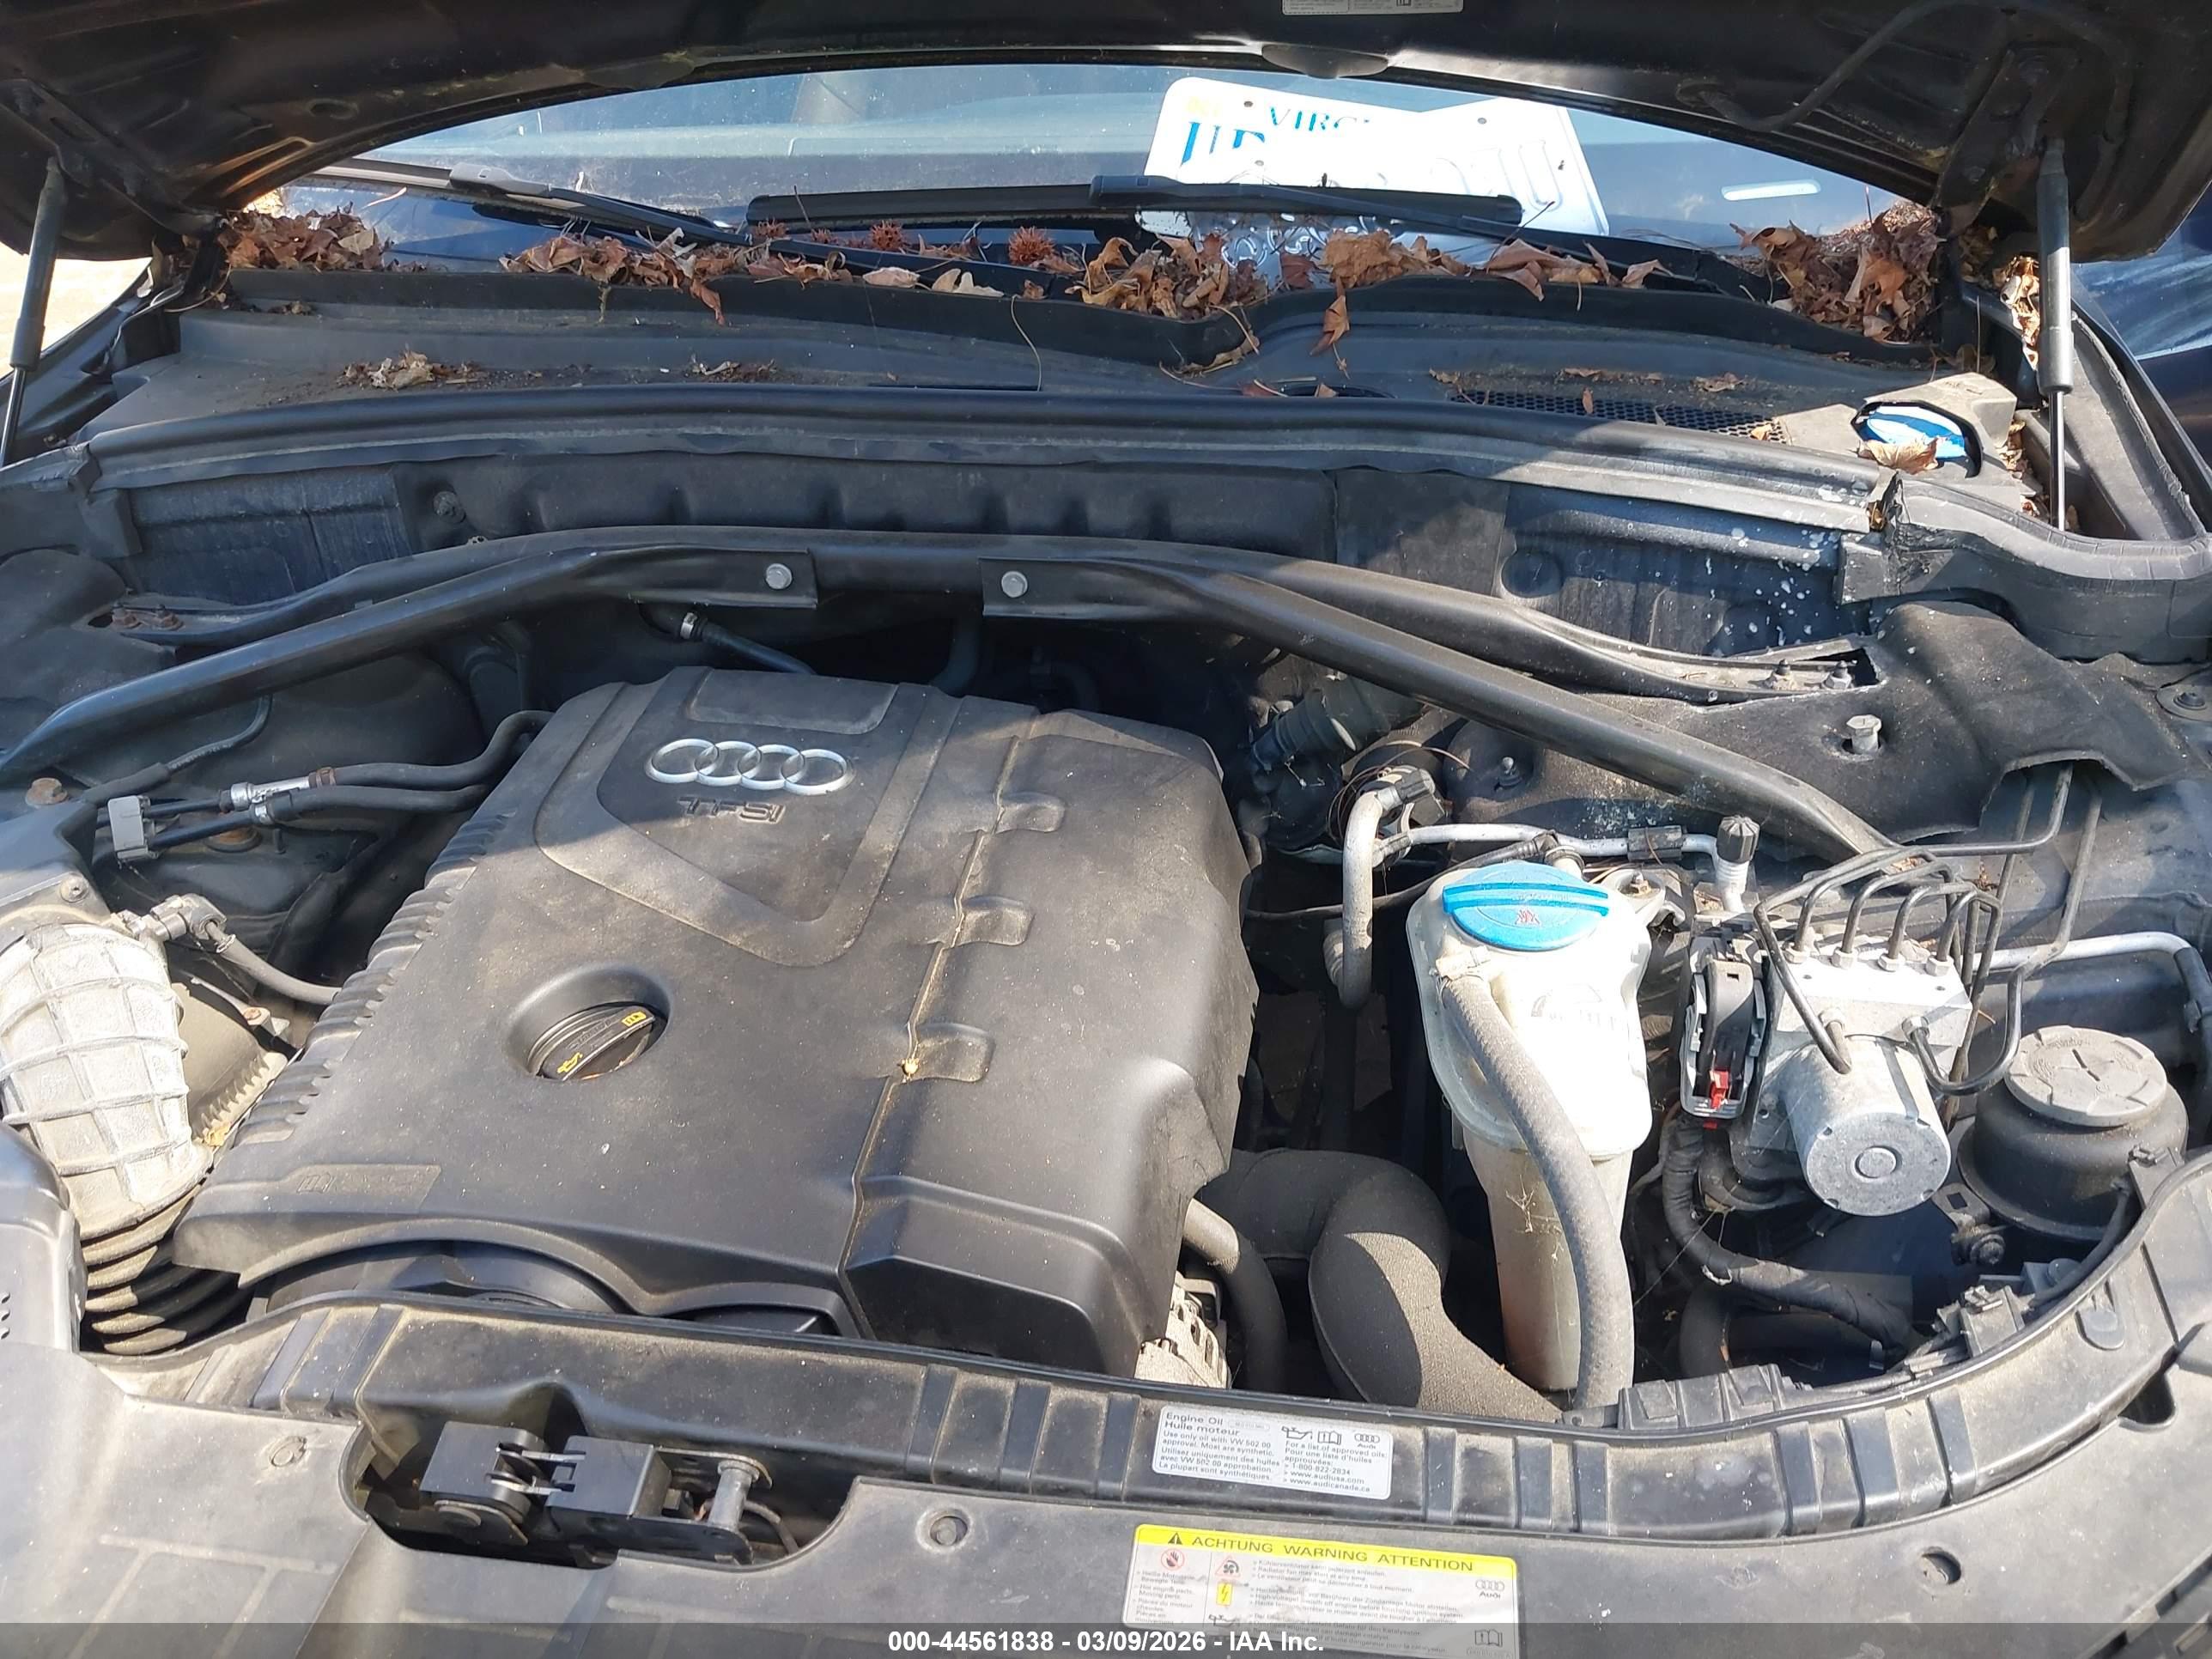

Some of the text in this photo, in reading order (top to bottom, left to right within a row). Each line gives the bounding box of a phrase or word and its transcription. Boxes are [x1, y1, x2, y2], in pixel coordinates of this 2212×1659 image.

[1166, 1412, 1204, 1423] Engine
[1208, 1416, 1223, 1425] Oil
[1164, 1421, 1193, 1431] Huile
[1196, 1425, 1240, 1436] moteur
[1163, 1430, 1178, 1438] Use
[1180, 1431, 1196, 1440] only
[1199, 1433, 1208, 1442] oil
[1211, 1435, 1227, 1443] with
[1230, 1437, 1243, 1445] VW
[1245, 1438, 1258, 1447] 502
[1200, 1442, 1220, 1450] Most
[1331, 1445, 1369, 1455] approved
[1191, 1449, 1238, 1462] uniquement
[1240, 1455, 1254, 1463] des
[1256, 1456, 1279, 1467] huiles
[1211, 1459, 1221, 1468] 00
[1158, 1462, 1168, 1470] La
[1170, 1462, 1198, 1473] plupart
[1200, 1466, 1217, 1475] sont
[1192, 1534, 1474, 1572] ACHTUNG WARNING ATTENTION
